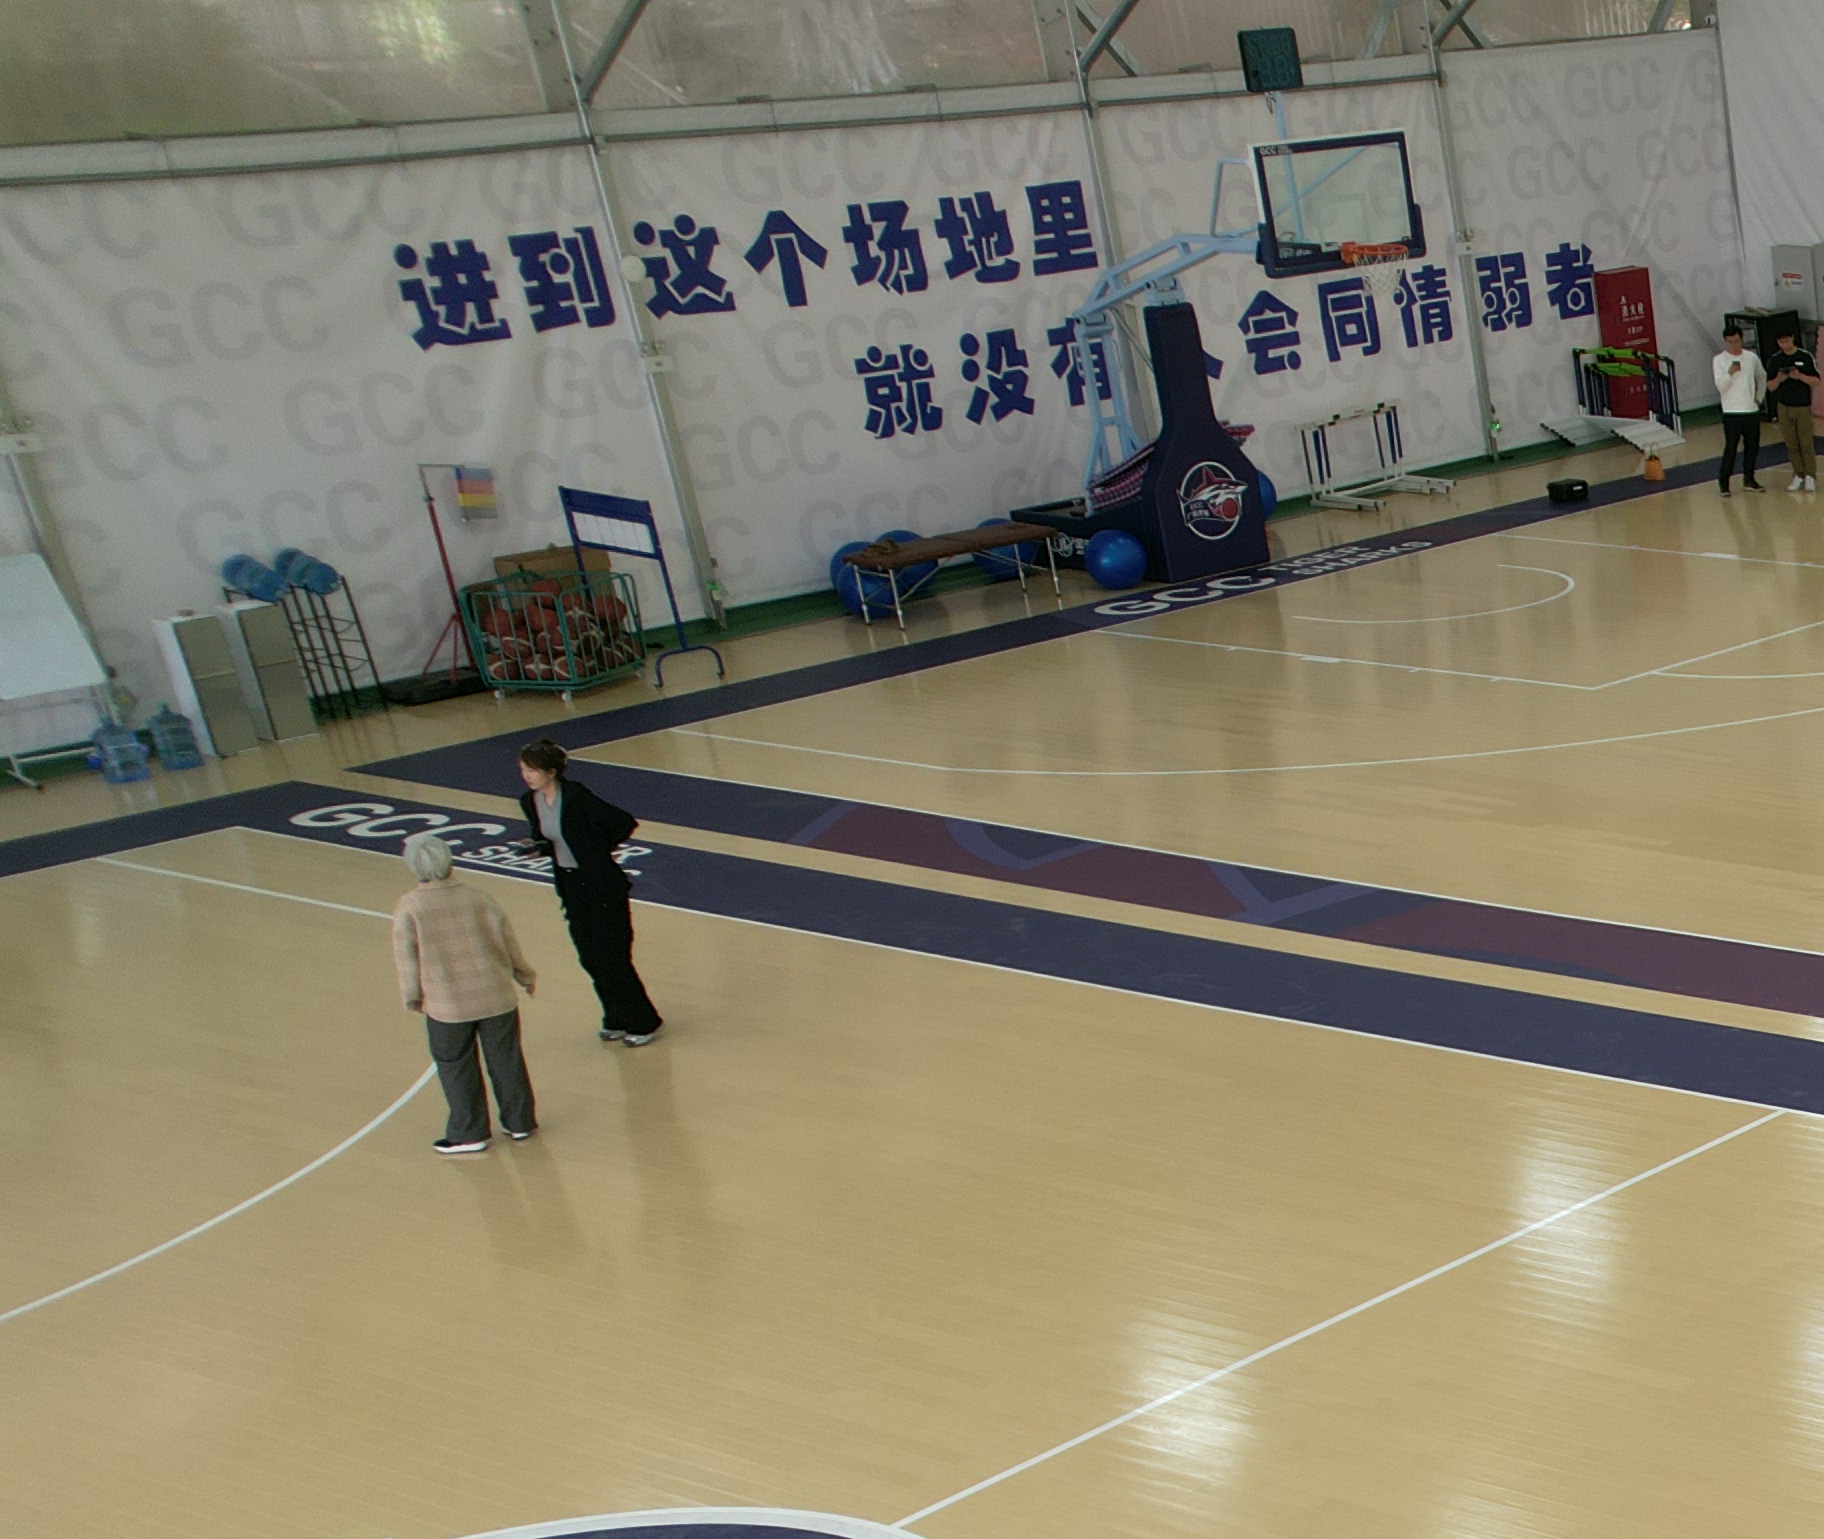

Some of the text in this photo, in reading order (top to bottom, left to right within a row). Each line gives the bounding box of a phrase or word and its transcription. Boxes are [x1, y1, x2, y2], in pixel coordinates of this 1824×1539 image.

[393, 179, 1099, 351] 进到这个场地里
[106, 274, 331, 369] GCC
[854, 241, 1595, 440] 就没有会同情弱者
[284, 362, 484, 458] GCC
[1094, 545, 1370, 616] GCC TIGER
[1292, 541, 1433, 576] SHARKS
